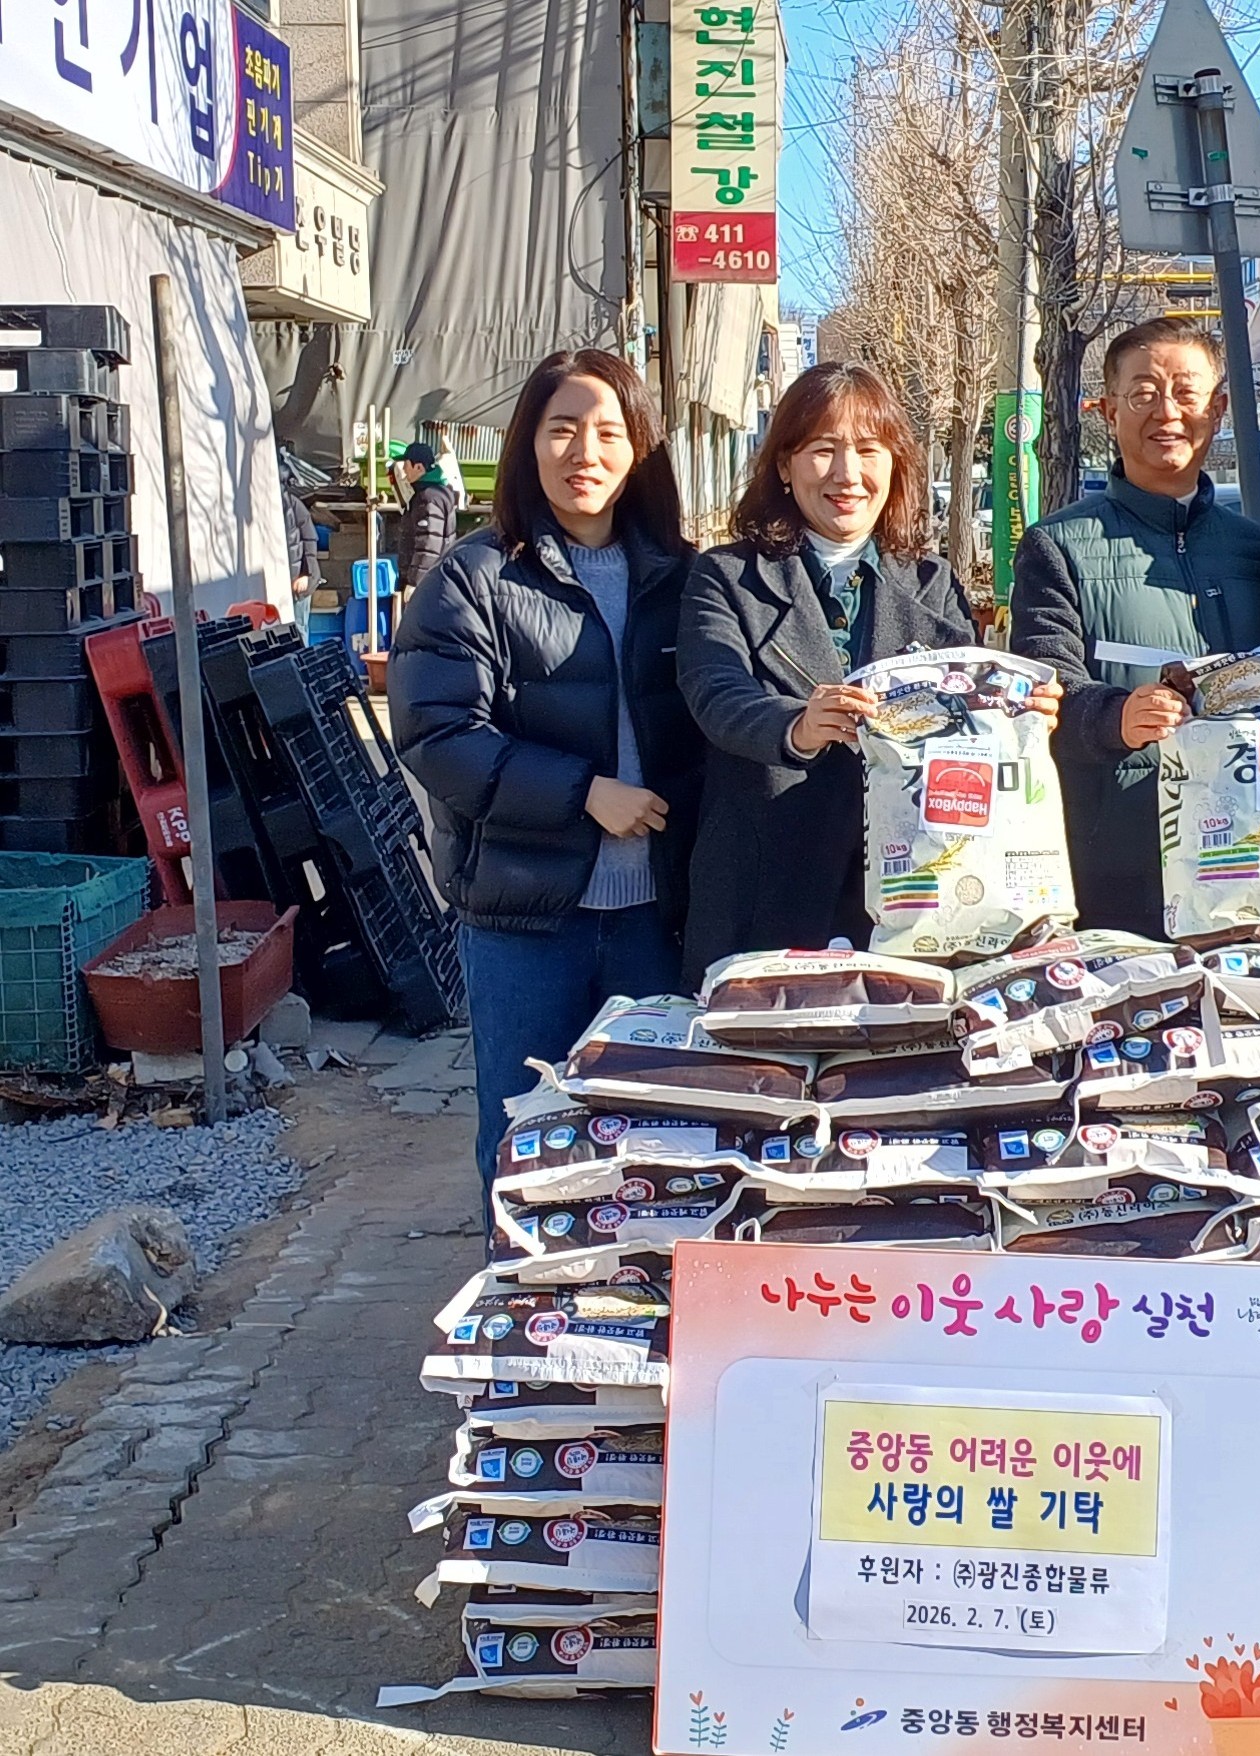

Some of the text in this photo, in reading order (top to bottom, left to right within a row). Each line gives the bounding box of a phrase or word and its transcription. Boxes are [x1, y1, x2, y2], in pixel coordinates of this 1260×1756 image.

[690, 6, 760, 206] 현진철강
[704, 223, 744, 243] 411
[698, 250, 771, 270] -4610
[928, 798, 988, 816] HappyBox
[761, 1272, 877, 1323] 나누는
[890, 1273, 984, 1338] 이웃
[994, 1283, 1120, 1344] 사랑
[1131, 1291, 1216, 1339] 실천
[845, 1431, 1143, 1482] 중앙동 어려운 이웃에
[866, 1481, 1105, 1535] 사랑의 쌀 기탁
[856, 1554, 924, 1586] 후원자
[906, 1603, 959, 1627] 2026.
[1019, 1608, 1057, 1636] (토)
[900, 1708, 1147, 1743] 중앙동 행정복지센터
